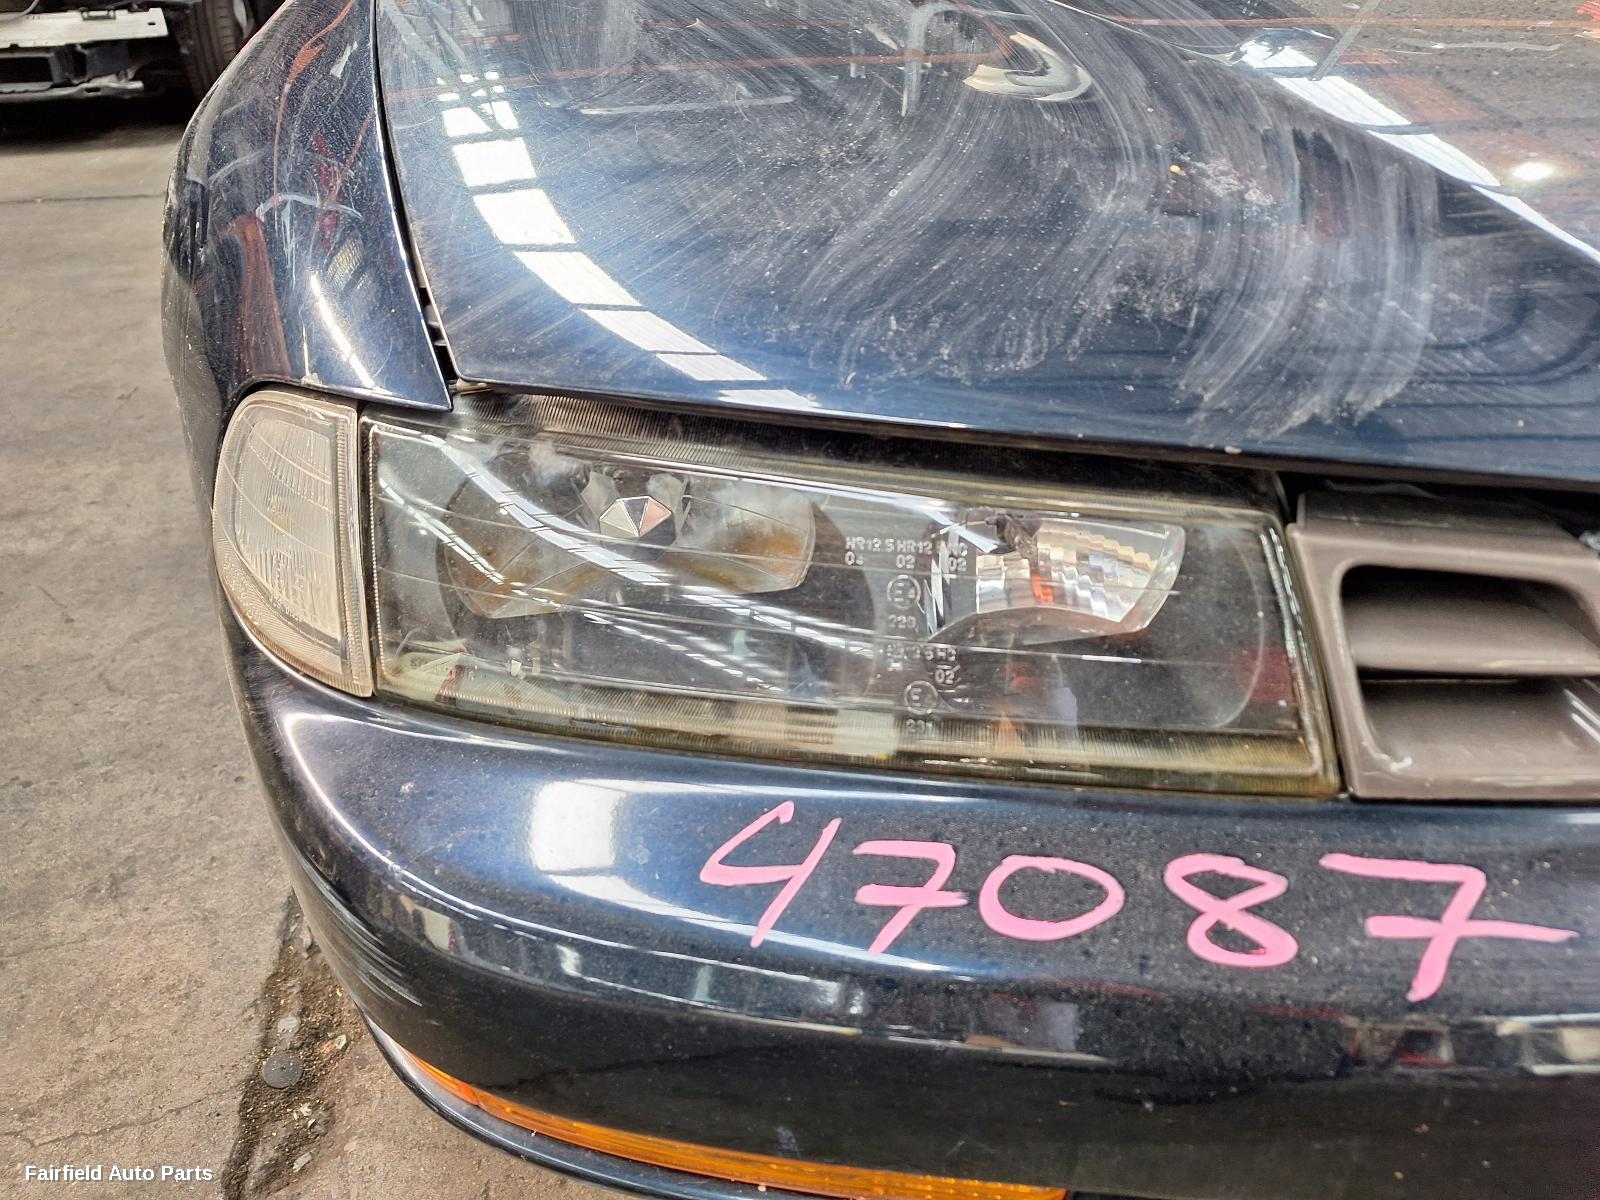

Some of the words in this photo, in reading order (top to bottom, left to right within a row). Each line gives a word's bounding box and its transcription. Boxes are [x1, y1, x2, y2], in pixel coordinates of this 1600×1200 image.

[895, 554, 915, 569] 02
[934, 669, 955, 684] 02
[700, 801, 1577, 1002] 47087
